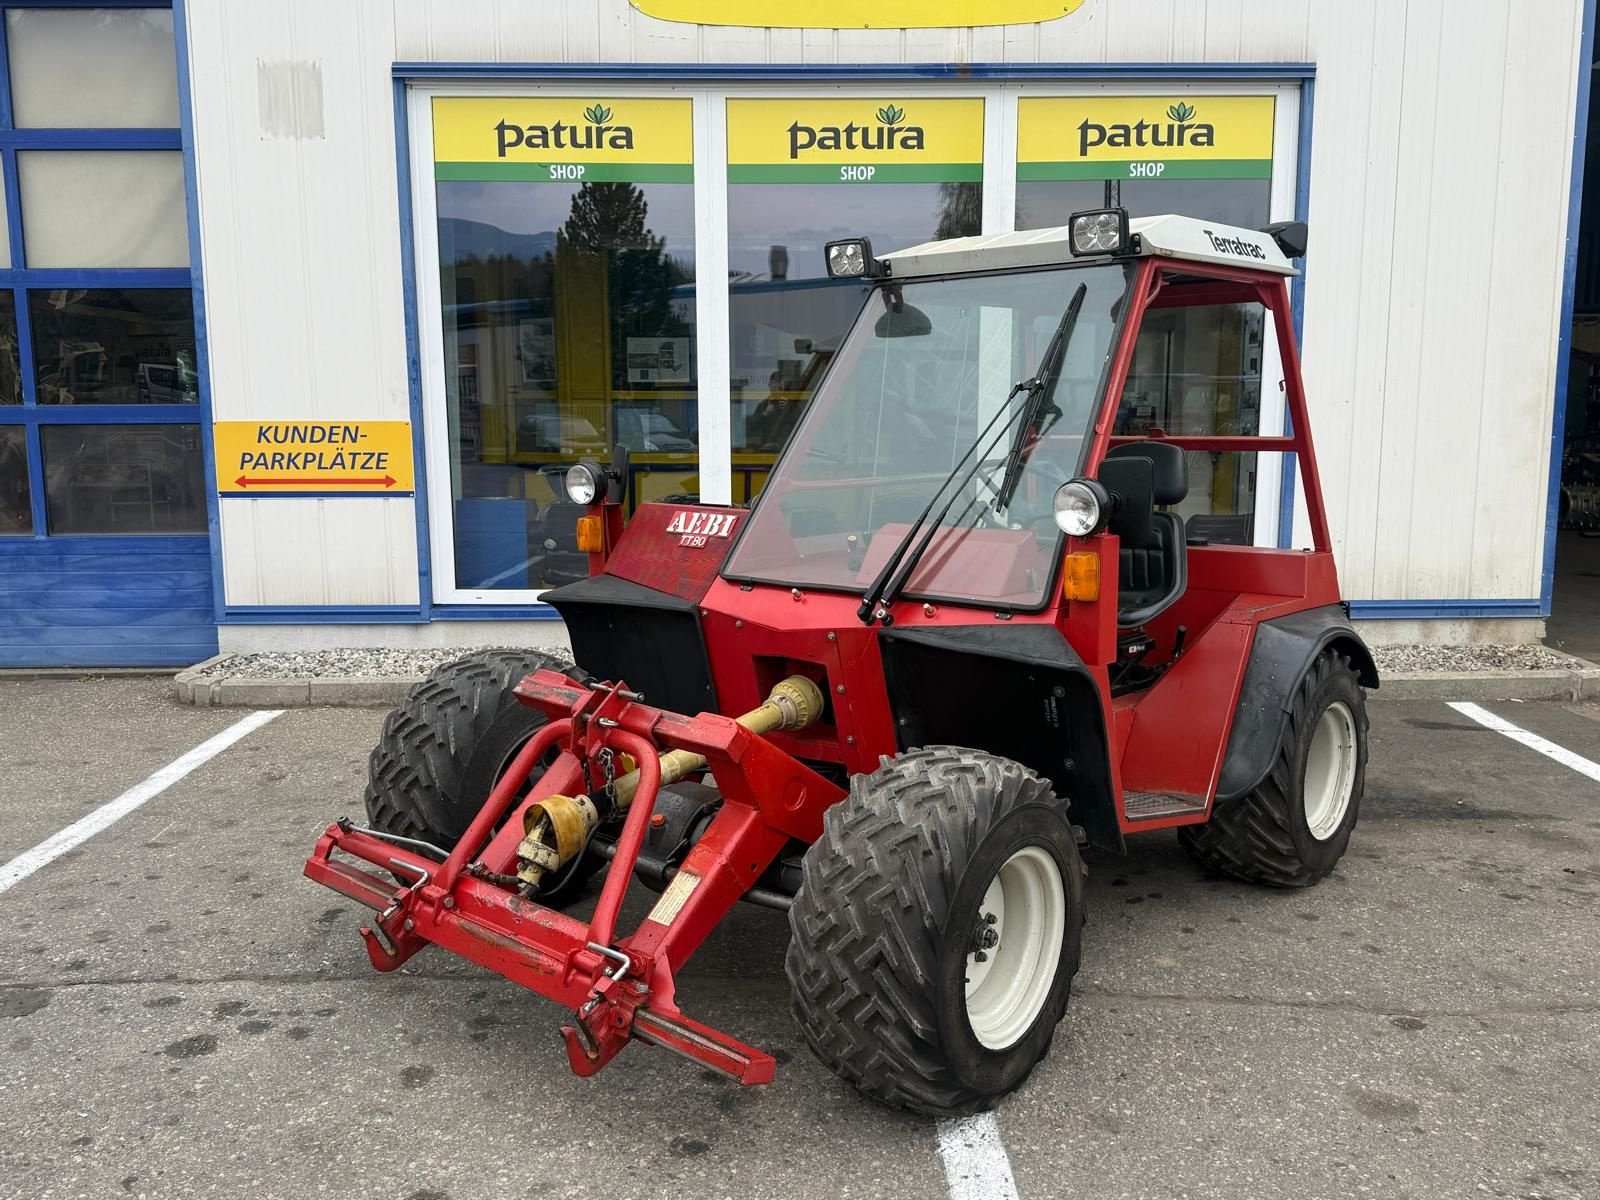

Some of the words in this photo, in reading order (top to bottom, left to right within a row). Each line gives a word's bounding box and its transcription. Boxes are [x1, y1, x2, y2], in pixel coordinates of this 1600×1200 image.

[494, 118, 634, 158] patura
[787, 120, 925, 159] patura
[1077, 117, 1214, 157] patura
[549, 165, 586, 180] SHOP
[840, 165, 876, 181] SHOP
[1129, 162, 1165, 177] SHOP
[1203, 229, 1266, 260] Terratrac
[257, 425, 368, 444] KUNDEN-
[239, 447, 389, 471] PARKPLÄTZE
[666, 511, 737, 537] AEBI
